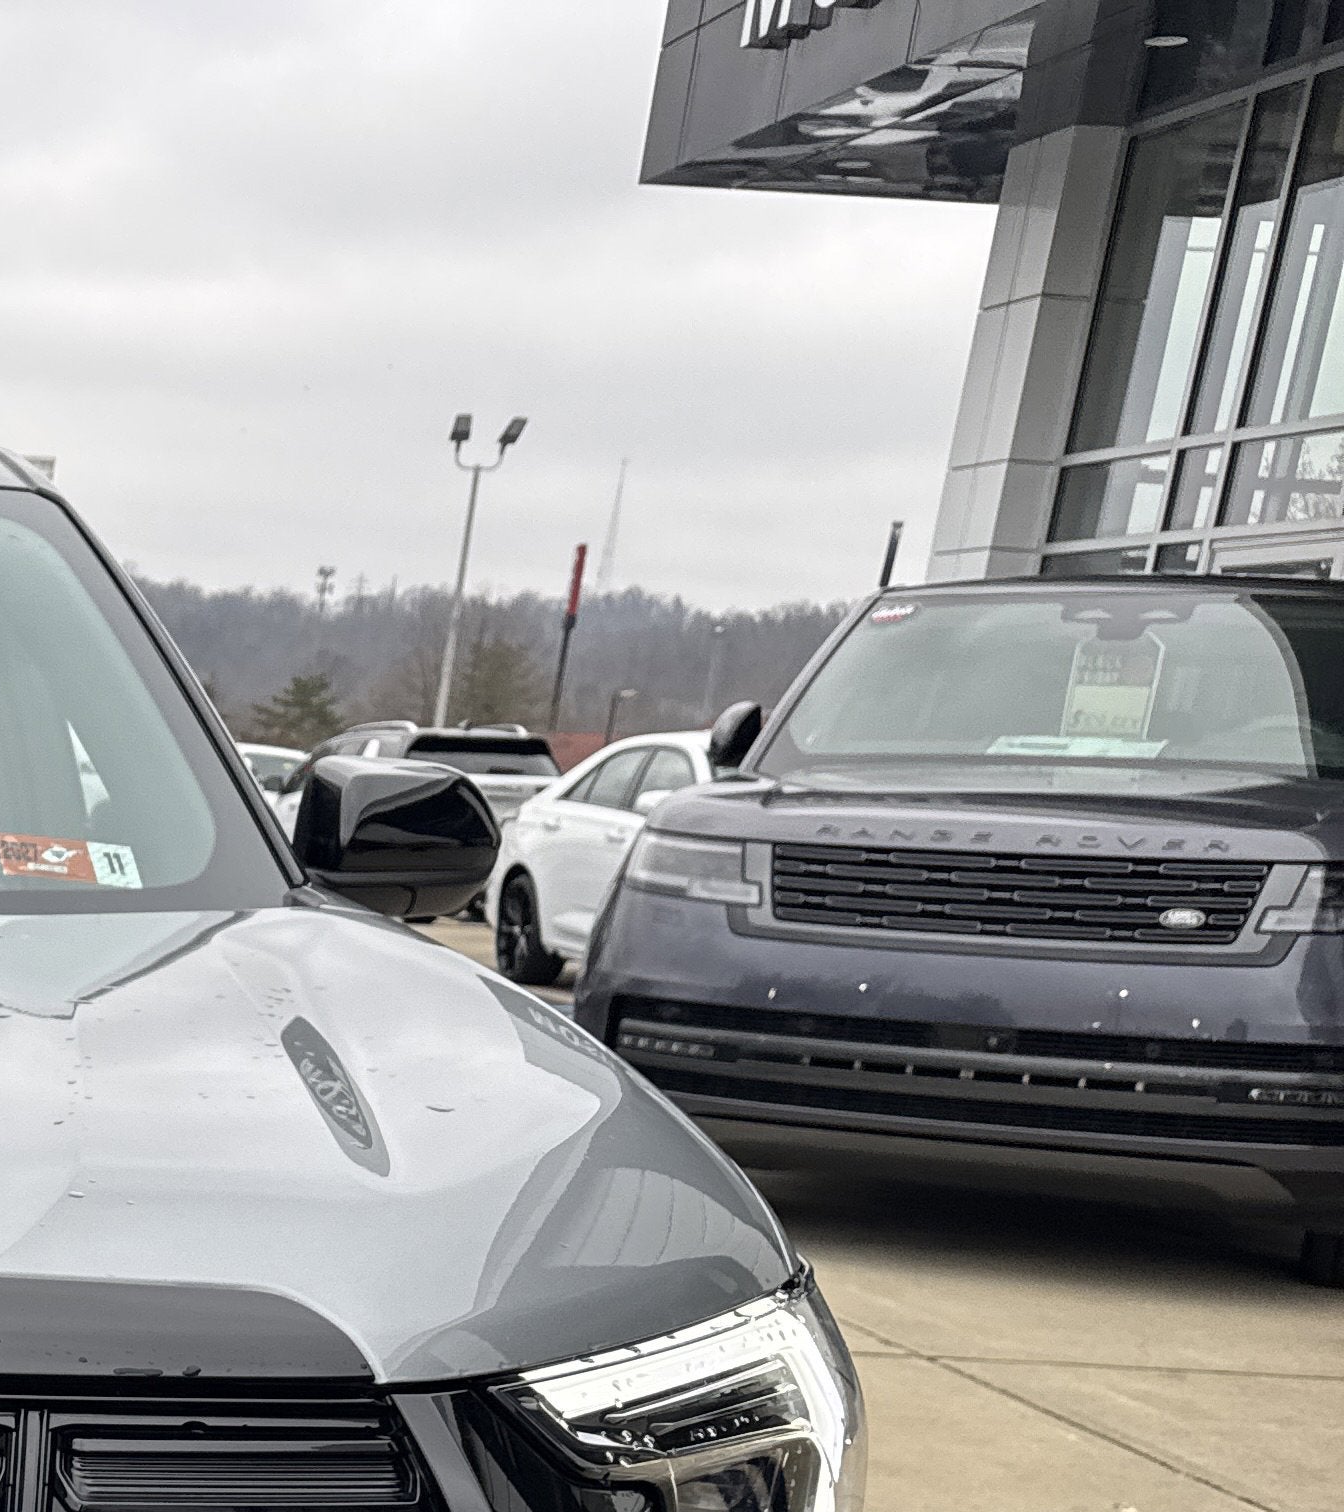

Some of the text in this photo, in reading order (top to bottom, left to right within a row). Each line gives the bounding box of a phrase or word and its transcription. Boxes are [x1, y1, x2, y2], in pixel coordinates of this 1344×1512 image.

[815, 823, 1231, 854] RANGE ROVER
[102, 851, 126, 876] 11
